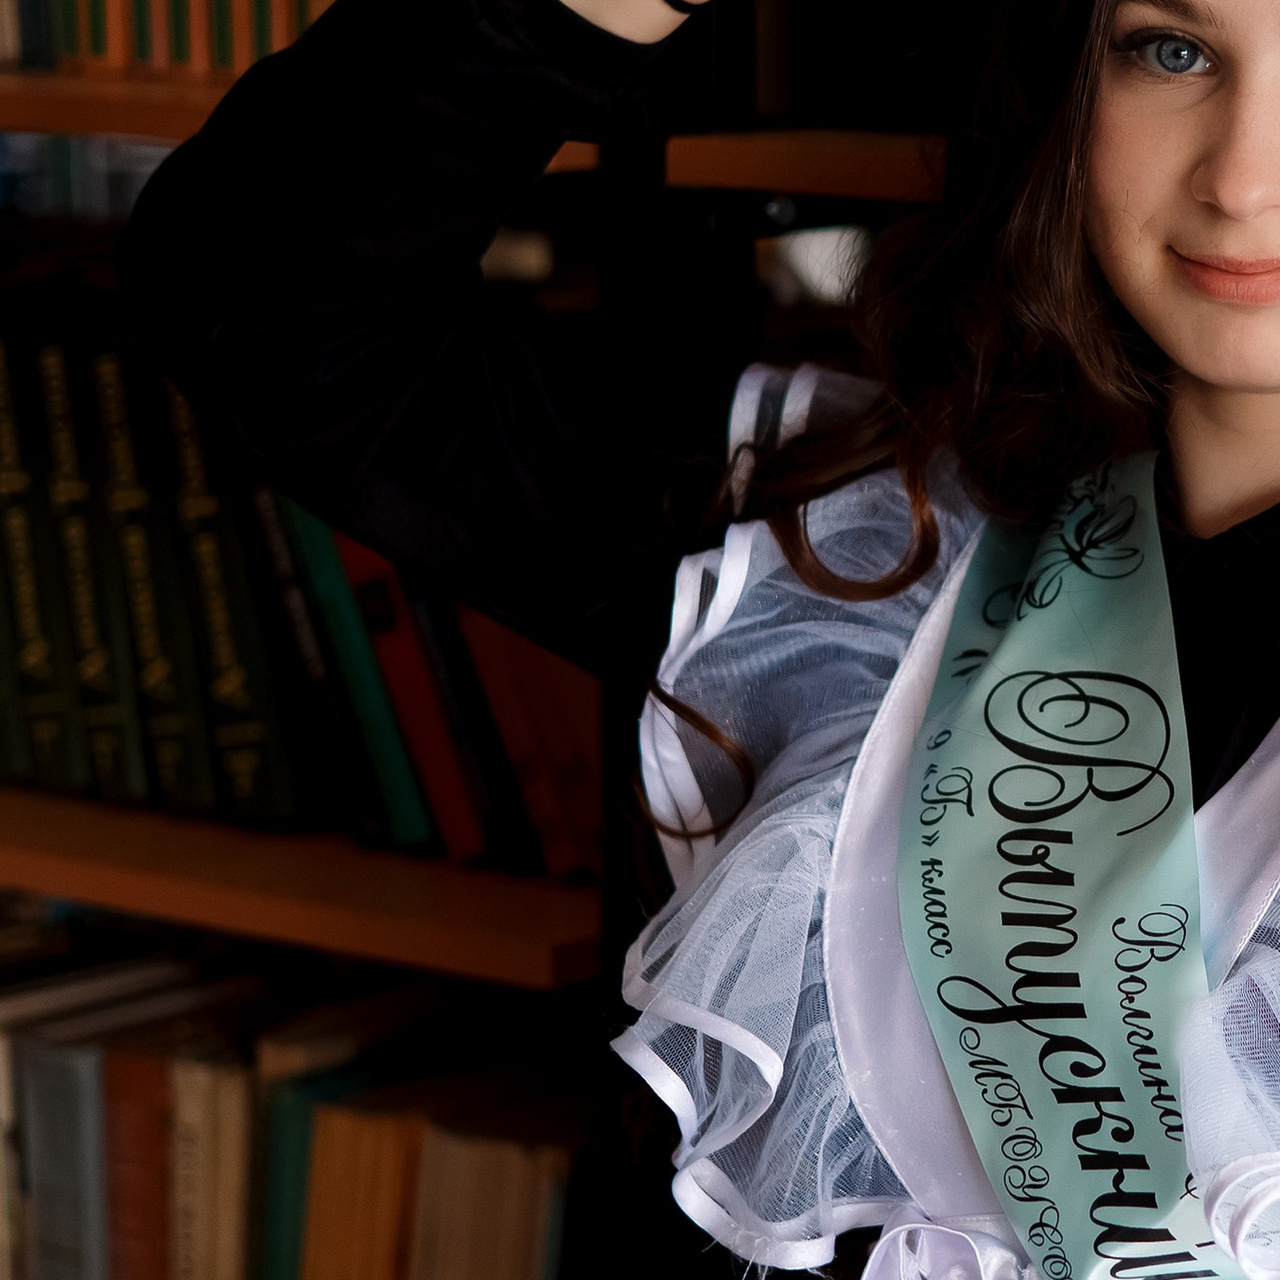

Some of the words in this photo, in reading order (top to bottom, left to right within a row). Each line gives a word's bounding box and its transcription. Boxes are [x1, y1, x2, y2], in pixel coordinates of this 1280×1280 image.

[926, 729, 952, 751] 9
[920, 763, 975, 848] «Б»
[920, 858, 953, 959] класс
[1111, 903, 1190, 1142] Волгина
[960, 1026, 1058, 1207] МБОУ
